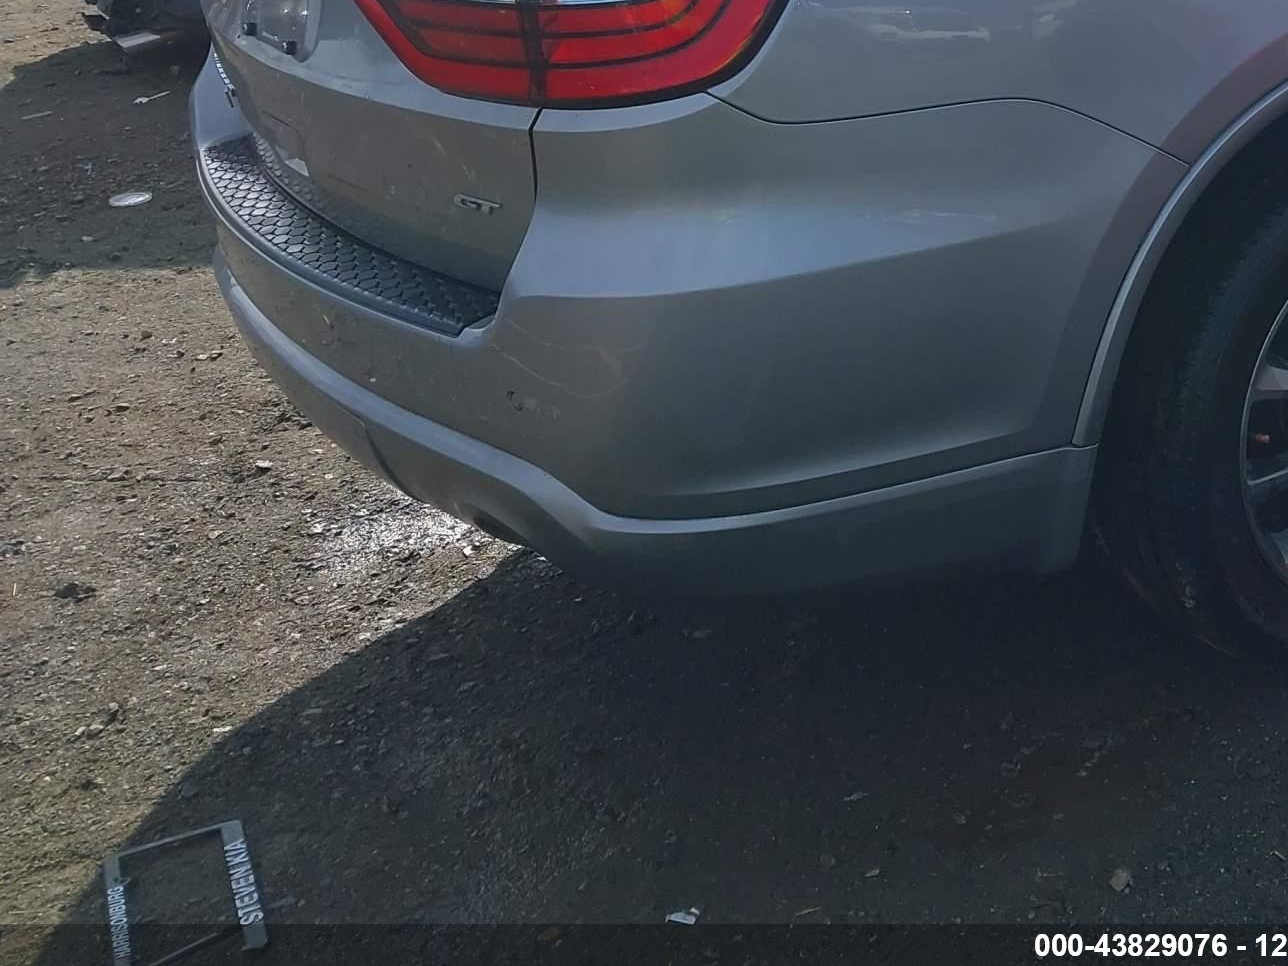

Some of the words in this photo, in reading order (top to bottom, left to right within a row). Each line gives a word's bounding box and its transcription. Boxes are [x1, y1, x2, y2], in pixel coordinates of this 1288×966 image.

[454, 193, 502, 215] GT
[223, 837, 249, 866] KIA
[229, 864, 264, 925] STEVEN
[106, 885, 132, 959] HARRISONBURG
